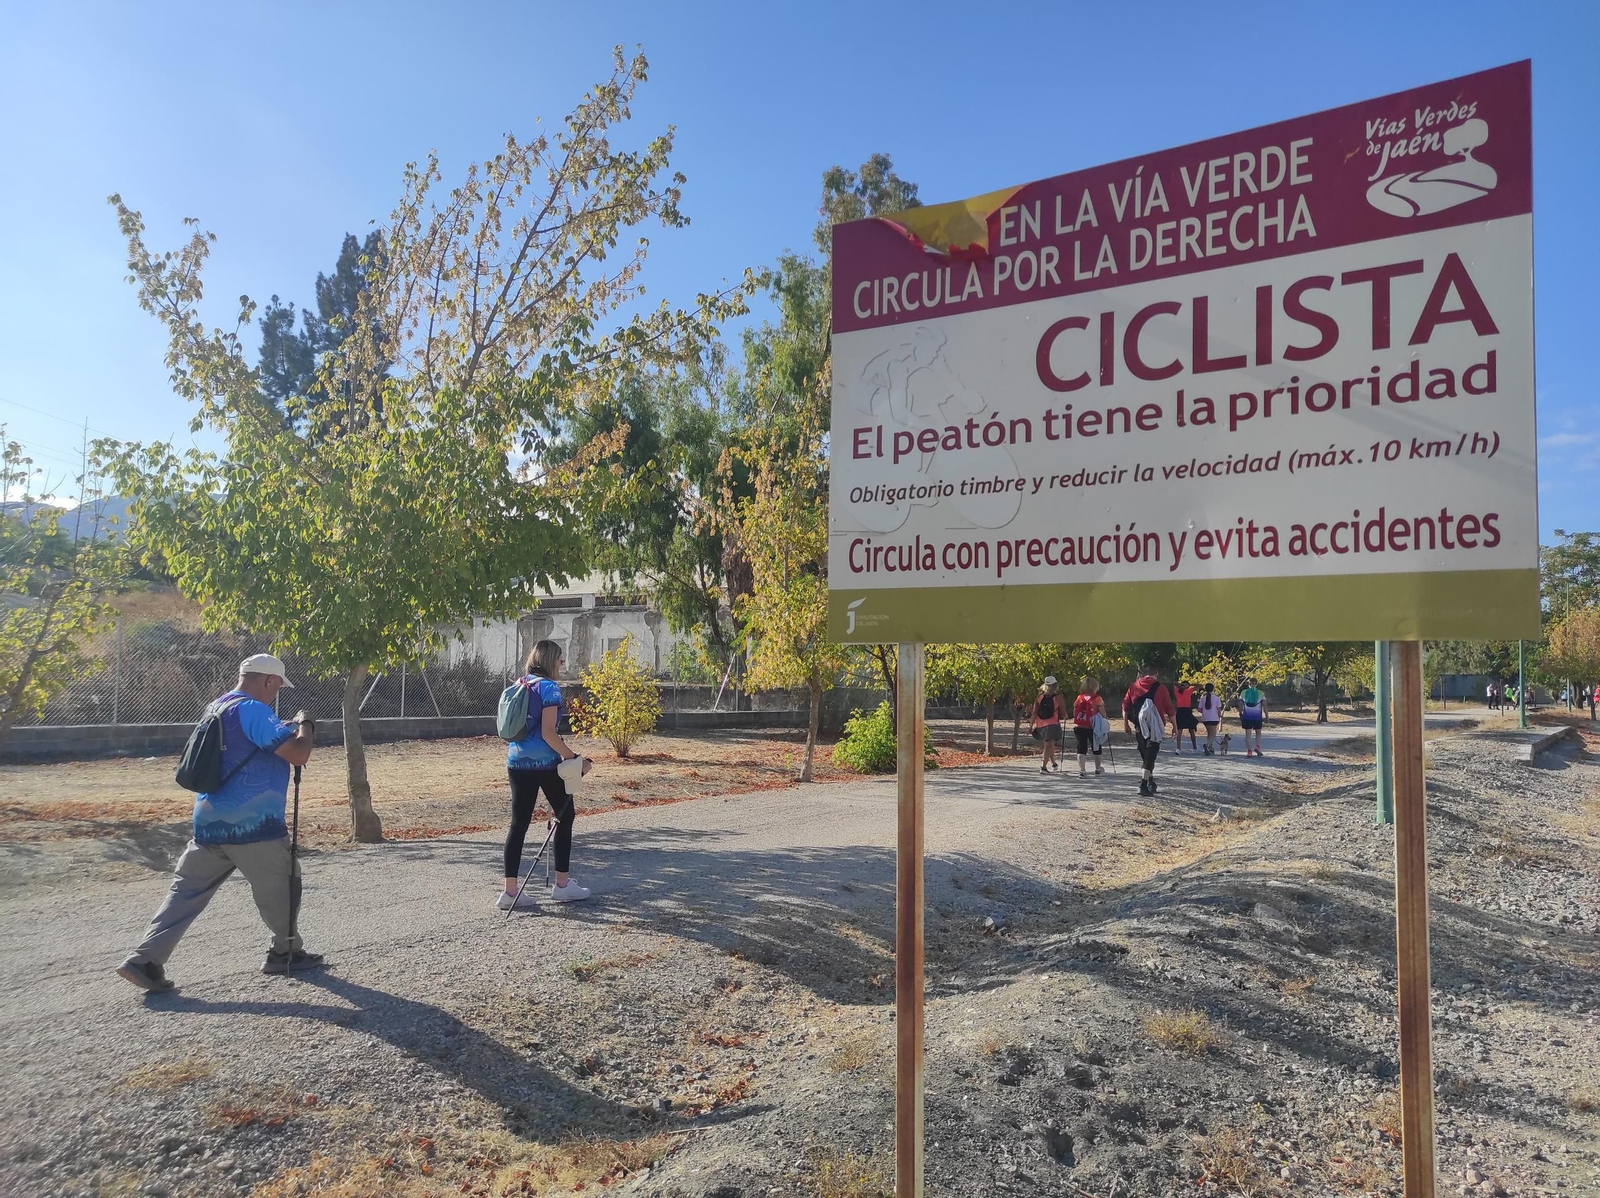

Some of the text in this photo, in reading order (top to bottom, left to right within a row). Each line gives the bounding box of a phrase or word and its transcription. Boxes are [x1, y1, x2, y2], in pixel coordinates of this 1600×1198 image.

[1365, 100, 1478, 140] Vías Verdes
[1365, 127, 1443, 182] de Jaén
[1000, 137, 1314, 248] EN LA VÍA VERDE
[853, 193, 1317, 320] CIRCULA POR LA DERECHA
[1036, 254, 1498, 392] CICLISTA
[852, 350, 1497, 464] El peatón tiene la prioridad
[849, 431, 1501, 505] Obligatorio timbre y reducir la velocidad (máx. 10 km/h)
[849, 506, 1502, 578] Circula con precaución y evita accidentes
